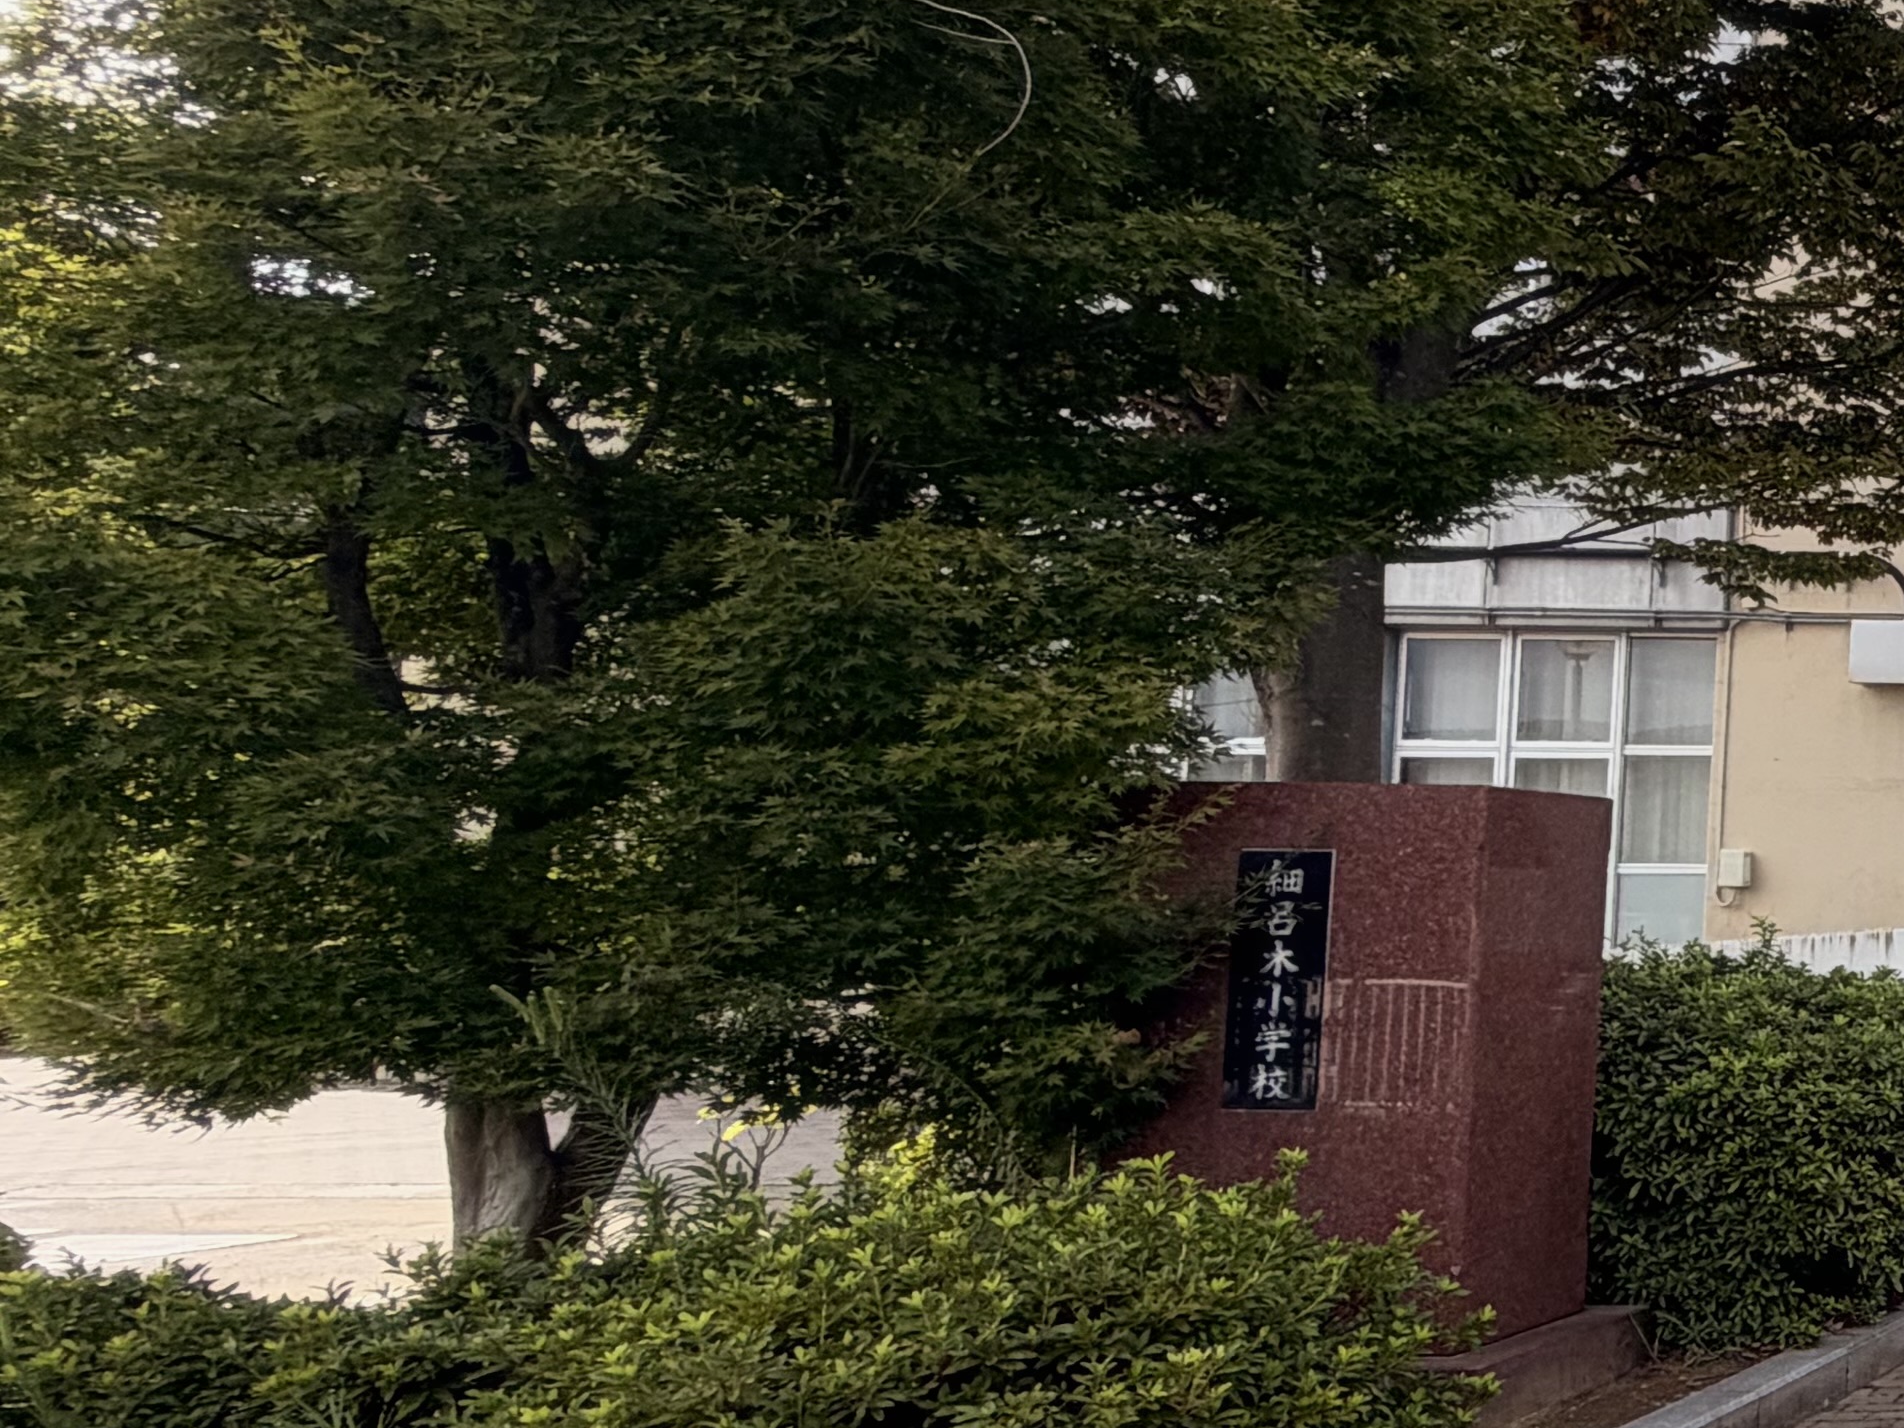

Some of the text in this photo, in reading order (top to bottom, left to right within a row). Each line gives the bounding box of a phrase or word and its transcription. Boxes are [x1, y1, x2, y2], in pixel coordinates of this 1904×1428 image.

[1248, 859, 1304, 1100] 細呂木小学校
